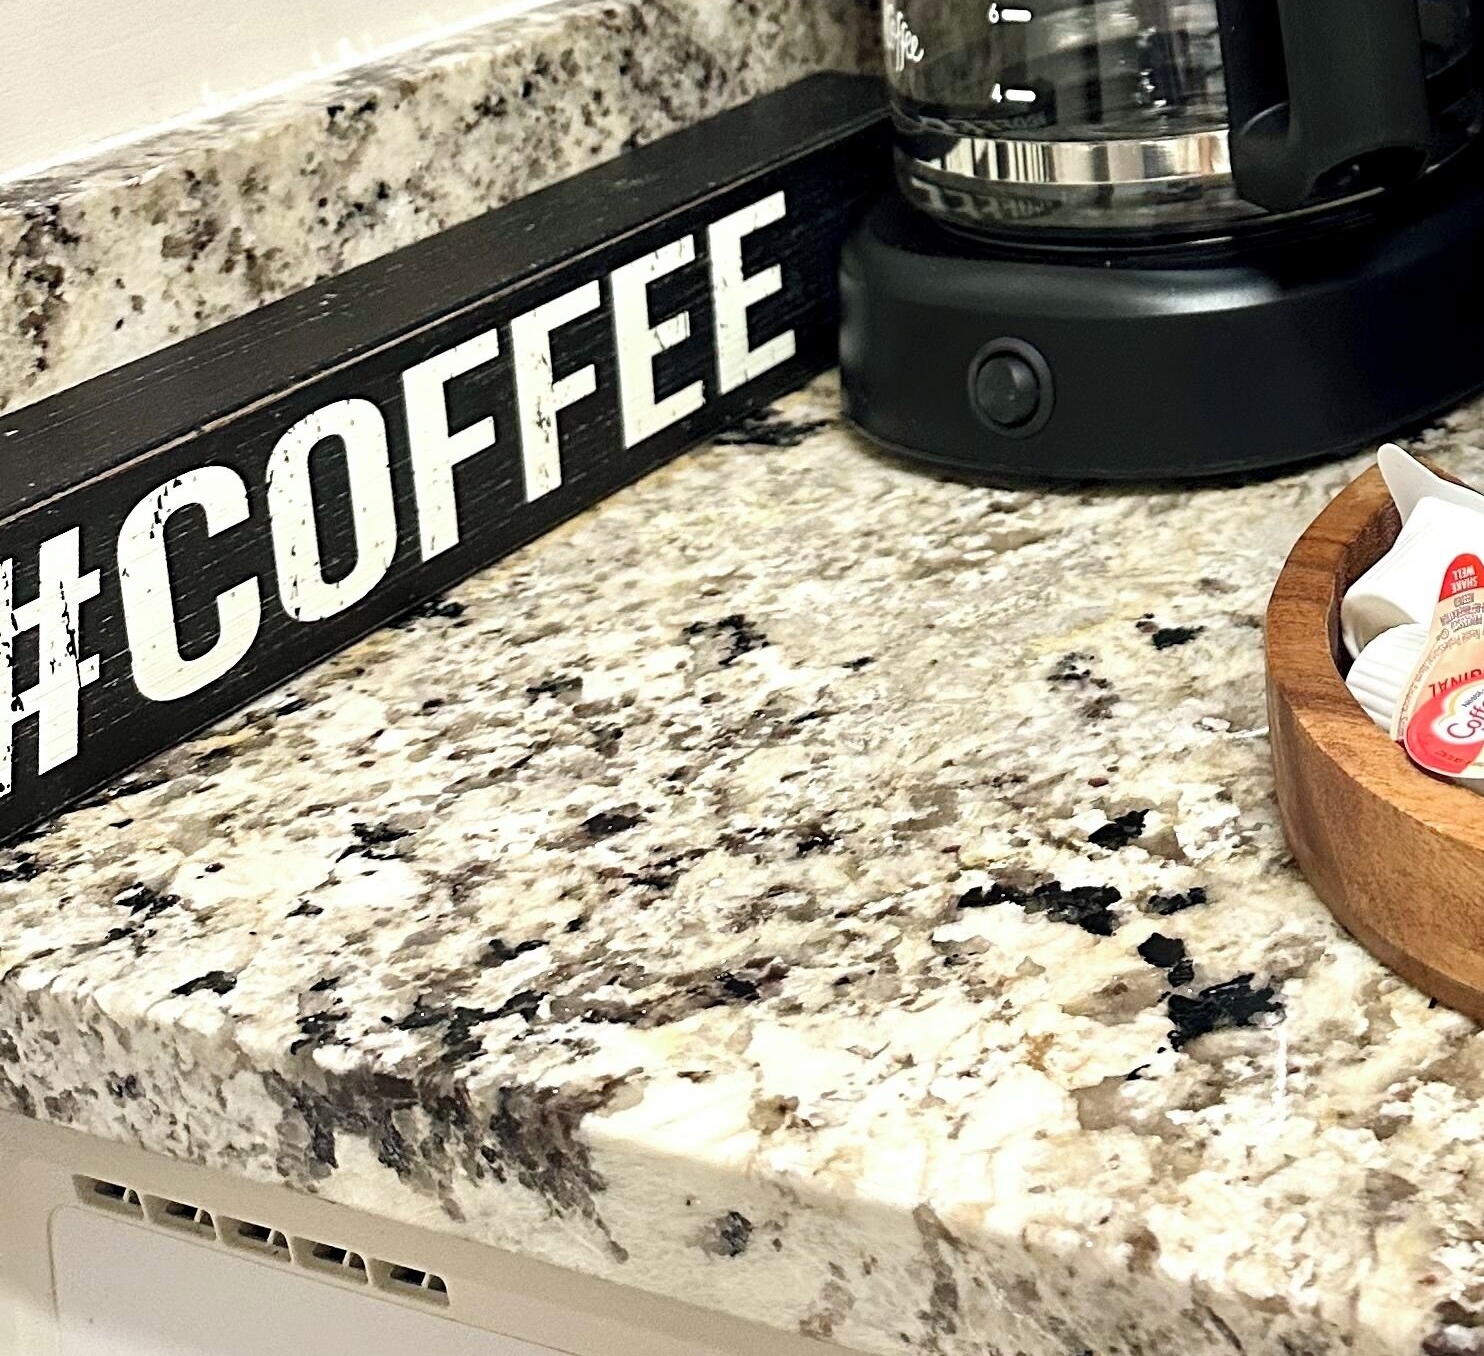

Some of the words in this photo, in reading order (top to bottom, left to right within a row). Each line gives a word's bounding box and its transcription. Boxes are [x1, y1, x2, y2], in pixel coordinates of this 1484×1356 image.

[988, 2, 1000, 24] 6
[991, 83, 1003, 103] 4
[0, 190, 797, 794] #COFFEE
[1452, 565, 1475, 581] WELL
[1452, 576, 1478, 593] SHAKE
